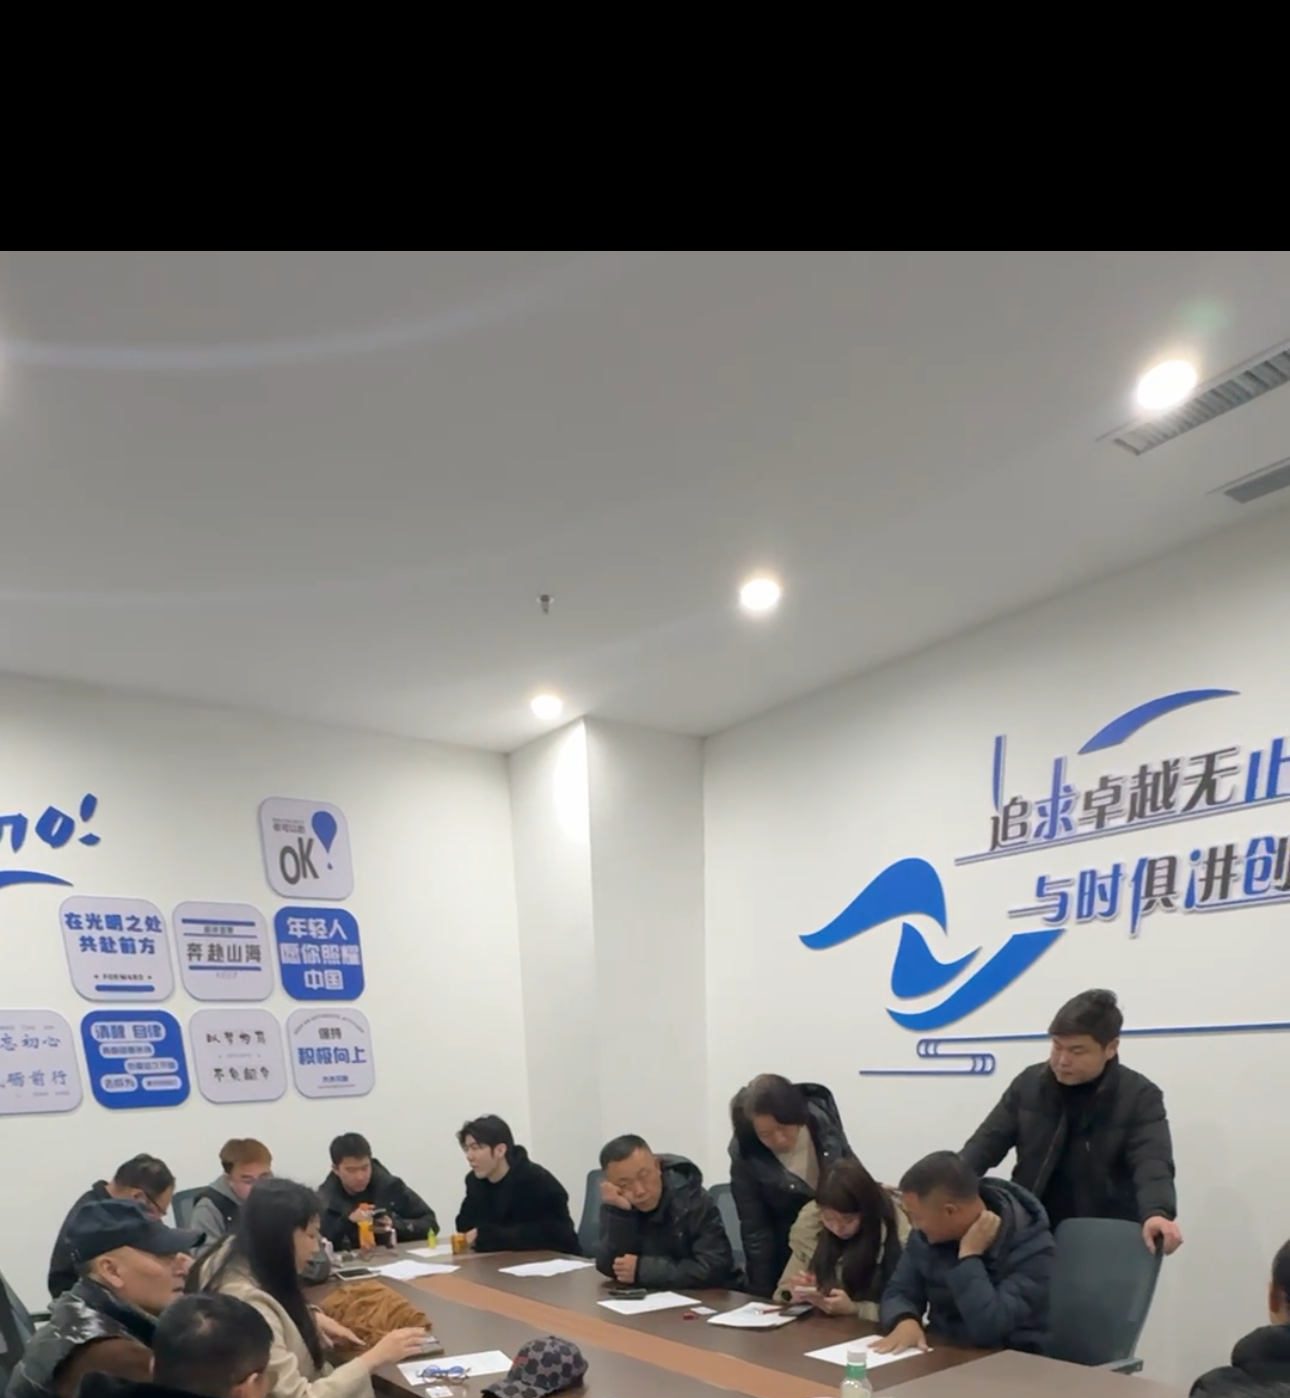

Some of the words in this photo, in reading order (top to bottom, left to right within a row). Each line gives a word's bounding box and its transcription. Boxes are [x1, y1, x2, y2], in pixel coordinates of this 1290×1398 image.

[1033, 835, 1290, 936] 与时俱进创
[63, 911, 163, 933] 在光明之处
[286, 916, 348, 941] 年轻人
[78, 934, 156, 955] 共赴前方
[186, 942, 262, 963] 奔赴山海
[304, 968, 345, 990] 中国
[297, 1045, 368, 1066] 积极向上
[0, 1069, 68, 1089] 砺前行
